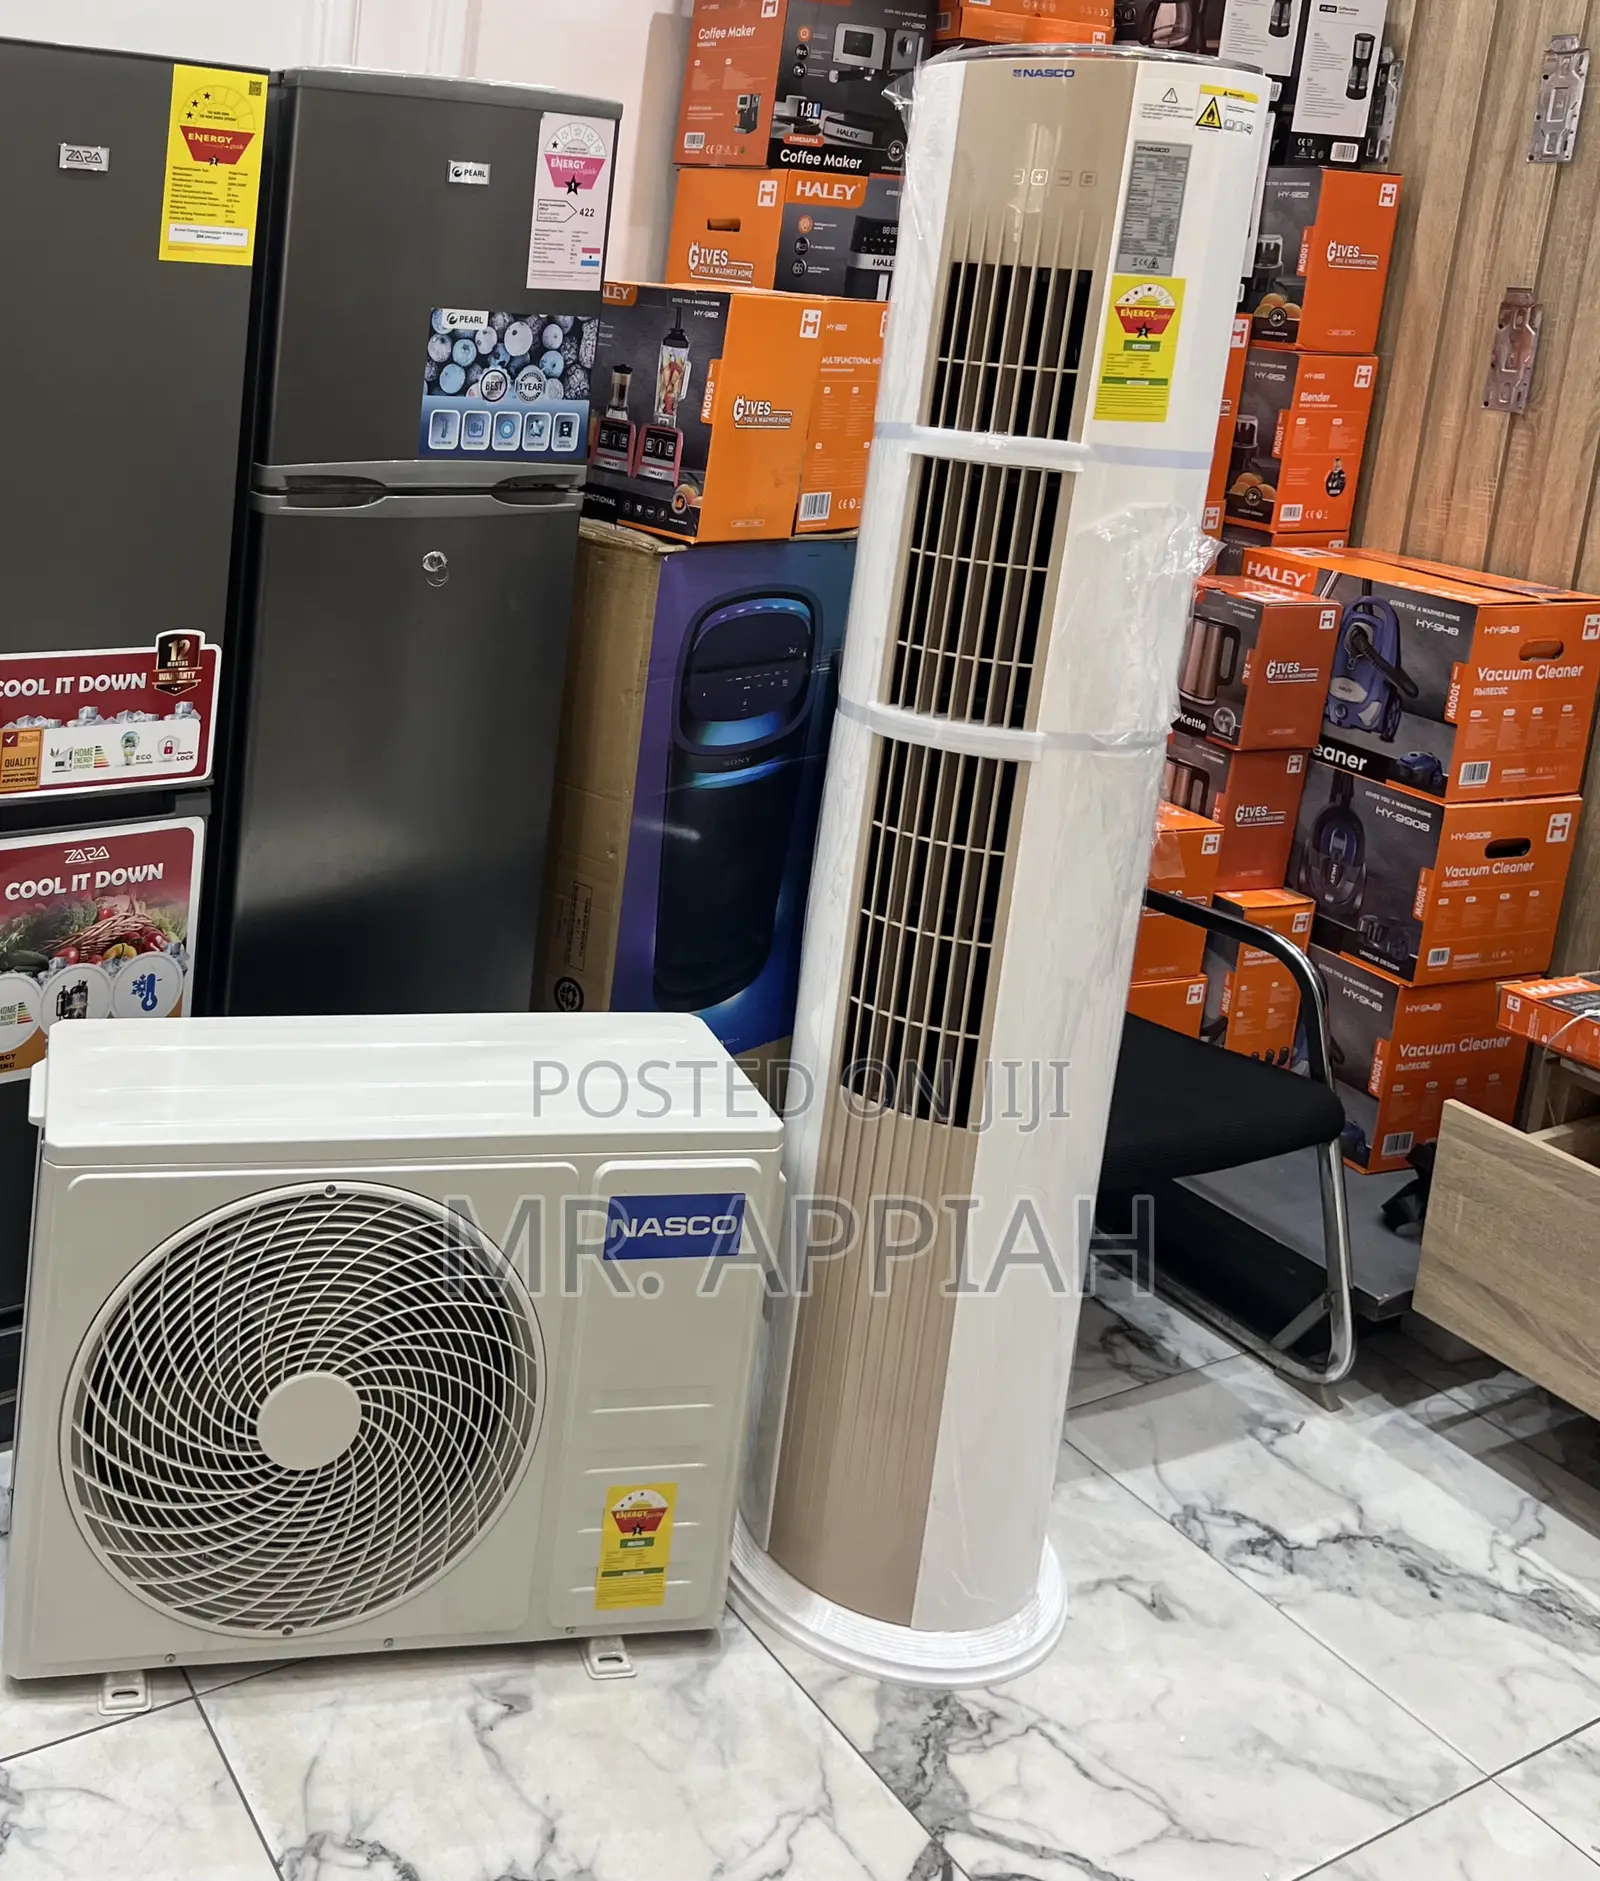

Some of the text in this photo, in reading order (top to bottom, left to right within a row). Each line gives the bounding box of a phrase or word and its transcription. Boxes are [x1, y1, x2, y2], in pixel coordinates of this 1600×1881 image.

[698, 24, 756, 40] Coffee Maker
[1023, 69, 1076, 78] NASCO
[188, 132, 233, 144] ENERGY
[836, 127, 860, 139] HALEY
[65, 149, 103, 164] ZARA
[551, 157, 586, 171] ENERGY
[780, 149, 862, 169] Coffee Maker
[463, 168, 487, 178] PEARL
[796, 180, 857, 200] HALEY
[579, 208, 595, 217] 422
[688, 241, 729, 271] GIVES
[1297, 243, 1309, 273] 1000W
[1326, 240, 1360, 262] GIVES
[699, 266, 709, 274] YOU
[715, 268, 738, 277] WARMER
[738, 270, 753, 278] HOME
[873, 259, 895, 268] HALE
[459, 315, 484, 324] PEARL
[1120, 308, 1156, 319] ENERGY
[485, 380, 504, 391] BEST
[702, 381, 715, 419] 5500W
[1300, 392, 1331, 402] Blender
[733, 396, 772, 421] GIVES
[1273, 426, 1284, 455] 1000W
[1246, 561, 1307, 588] HALEY
[1406, 603, 1417, 611] YOU
[1422, 606, 1445, 618] WARMER
[1445, 612, 1460, 622] HOME
[1416, 618, 1460, 636] HY-948
[168, 639, 190, 661] 12
[1266, 660, 1300, 679] GIVES
[1477, 664, 1584, 682] Vacuum Cleaner
[55, 675, 77, 695] IT
[78, 671, 147, 693] DOWN
[1446, 682, 1461, 719] 3000W
[1180, 712, 1207, 732] Kettle
[74, 747, 94, 757] HOME
[723, 756, 752, 767] SONY
[1311, 743, 1368, 772] eaner
[5, 756, 37, 768] QUALITY
[1, 776, 38, 784] APPROVED
[1213, 806, 1221, 822] 2.0
[1234, 804, 1268, 823] GIVES
[1376, 805, 1430, 832] HY-9908
[64, 845, 111, 864] ZARA
[1444, 861, 1535, 878] Vacuum Cleaner
[4, 862, 164, 901] COOL IT DOWN
[1415, 885, 1428, 918] 3000W
[1244, 951, 1275, 960] Sandw
[1400, 1034, 1511, 1058] Vacuum Cleaner
[1370, 1058, 1384, 1093] 3000W
[610, 1215, 738, 1239] NASCO
